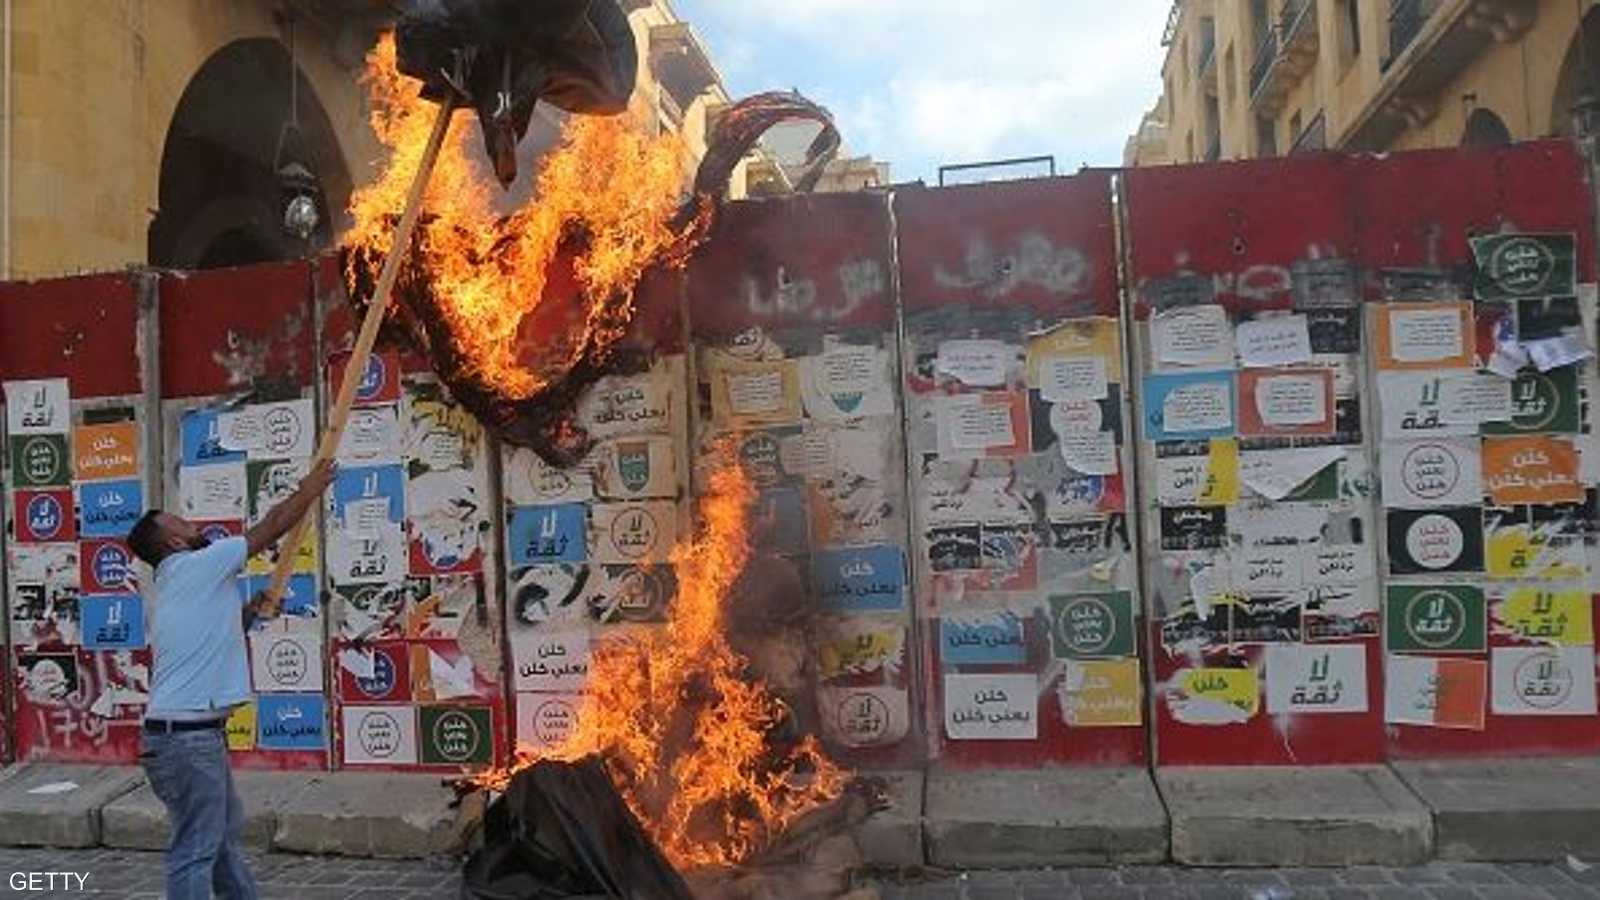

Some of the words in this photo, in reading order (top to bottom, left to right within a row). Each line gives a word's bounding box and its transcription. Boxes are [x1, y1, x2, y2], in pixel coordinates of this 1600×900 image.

[34, 387, 46, 408] لا
[616, 388, 644, 404] كلن
[1420, 378, 1440, 406] لا
[1521, 379, 1537, 399] لا
[23, 412, 52, 427] ثقة
[595, 409, 625, 424] كلن
[627, 407, 666, 422] يعني
[1401, 410, 1445, 430] قة
[1414, 454, 1445, 466] كلن
[1512, 450, 1550, 467] كلن
[363, 472, 377, 496] لا
[1416, 478, 1447, 492] كلن
[1488, 473, 1526, 490] كلن
[98, 490, 125, 508] كلن
[541, 510, 557, 537] لا
[630, 515, 643, 531] لا
[526, 534, 569, 557] ثقة
[619, 530, 651, 546] ثقة
[351, 556, 387, 578] ثقة
[840, 560, 874, 578] كلن
[1429, 598, 1444, 618] لا
[1533, 591, 1553, 613] لا
[108, 601, 123, 624] لا
[1072, 606, 1101, 620] كلن
[1416, 616, 1453, 632] ثقة
[1513, 612, 1568, 637] ثقة
[96, 623, 130, 643] ثقة
[950, 630, 983, 647] كلن
[1073, 630, 1103, 645] كلن
[538, 643, 566, 659] كلن
[520, 663, 549, 678] كلن
[551, 664, 588, 679] يعني
[1309, 654, 1329, 682] لا
[1538, 660, 1553, 680] لا
[1192, 676, 1229, 694] كلن
[1291, 680, 1345, 705] ثقة
[1524, 681, 1561, 697] ثقة
[973, 688, 1008, 705] كلن
[278, 706, 301, 721] كلن
[859, 698, 872, 718] لا
[952, 708, 985, 725] كلن
[987, 709, 1030, 725] يعني
[262, 722, 291, 738] كلن
